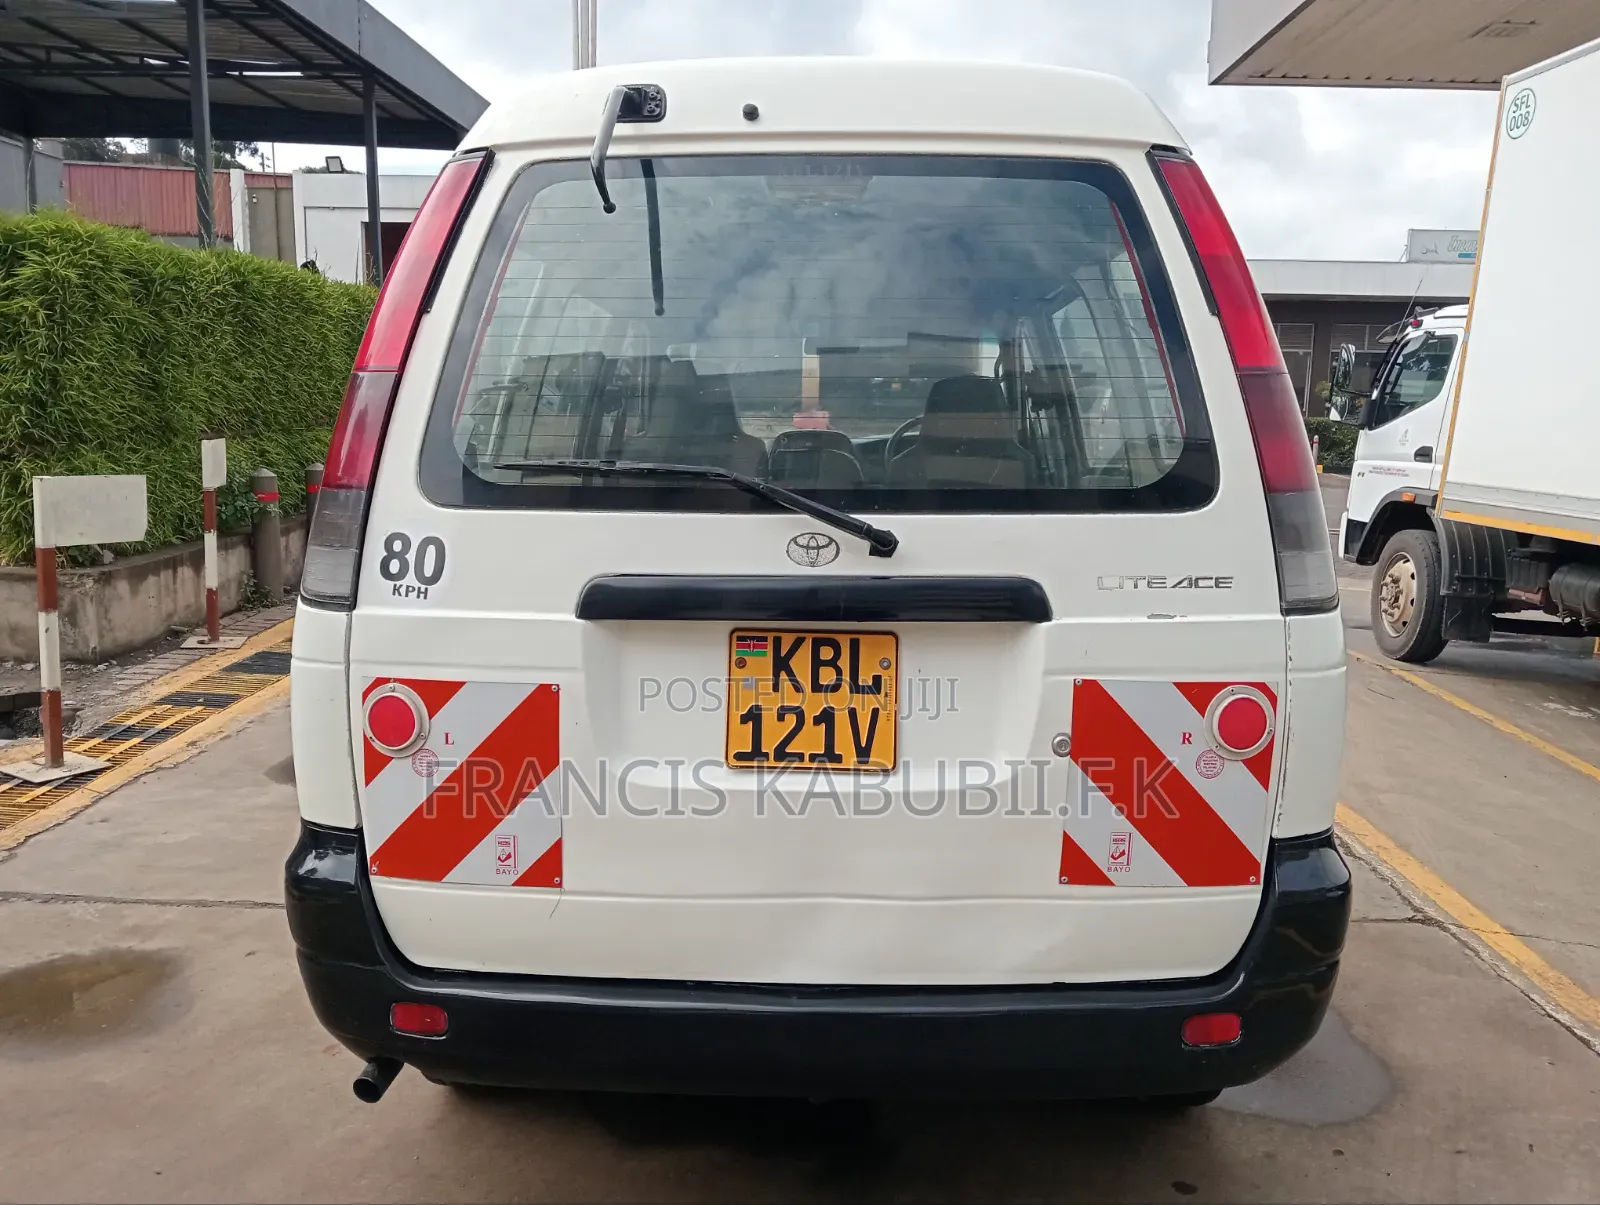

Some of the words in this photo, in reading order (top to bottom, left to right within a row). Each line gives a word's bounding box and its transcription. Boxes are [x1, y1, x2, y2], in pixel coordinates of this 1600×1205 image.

[1512, 93, 1531, 114] SFL
[1509, 110, 1531, 132] 008
[379, 532, 446, 587] 80
[391, 583, 429, 600] KPH
[1097, 575, 1234, 590] LITEACE
[771, 635, 883, 695] KBL
[443, 732, 455, 746] L
[732, 704, 881, 765] 121V
[1180, 732, 1193, 746] R
[496, 868, 519, 876] BAYO
